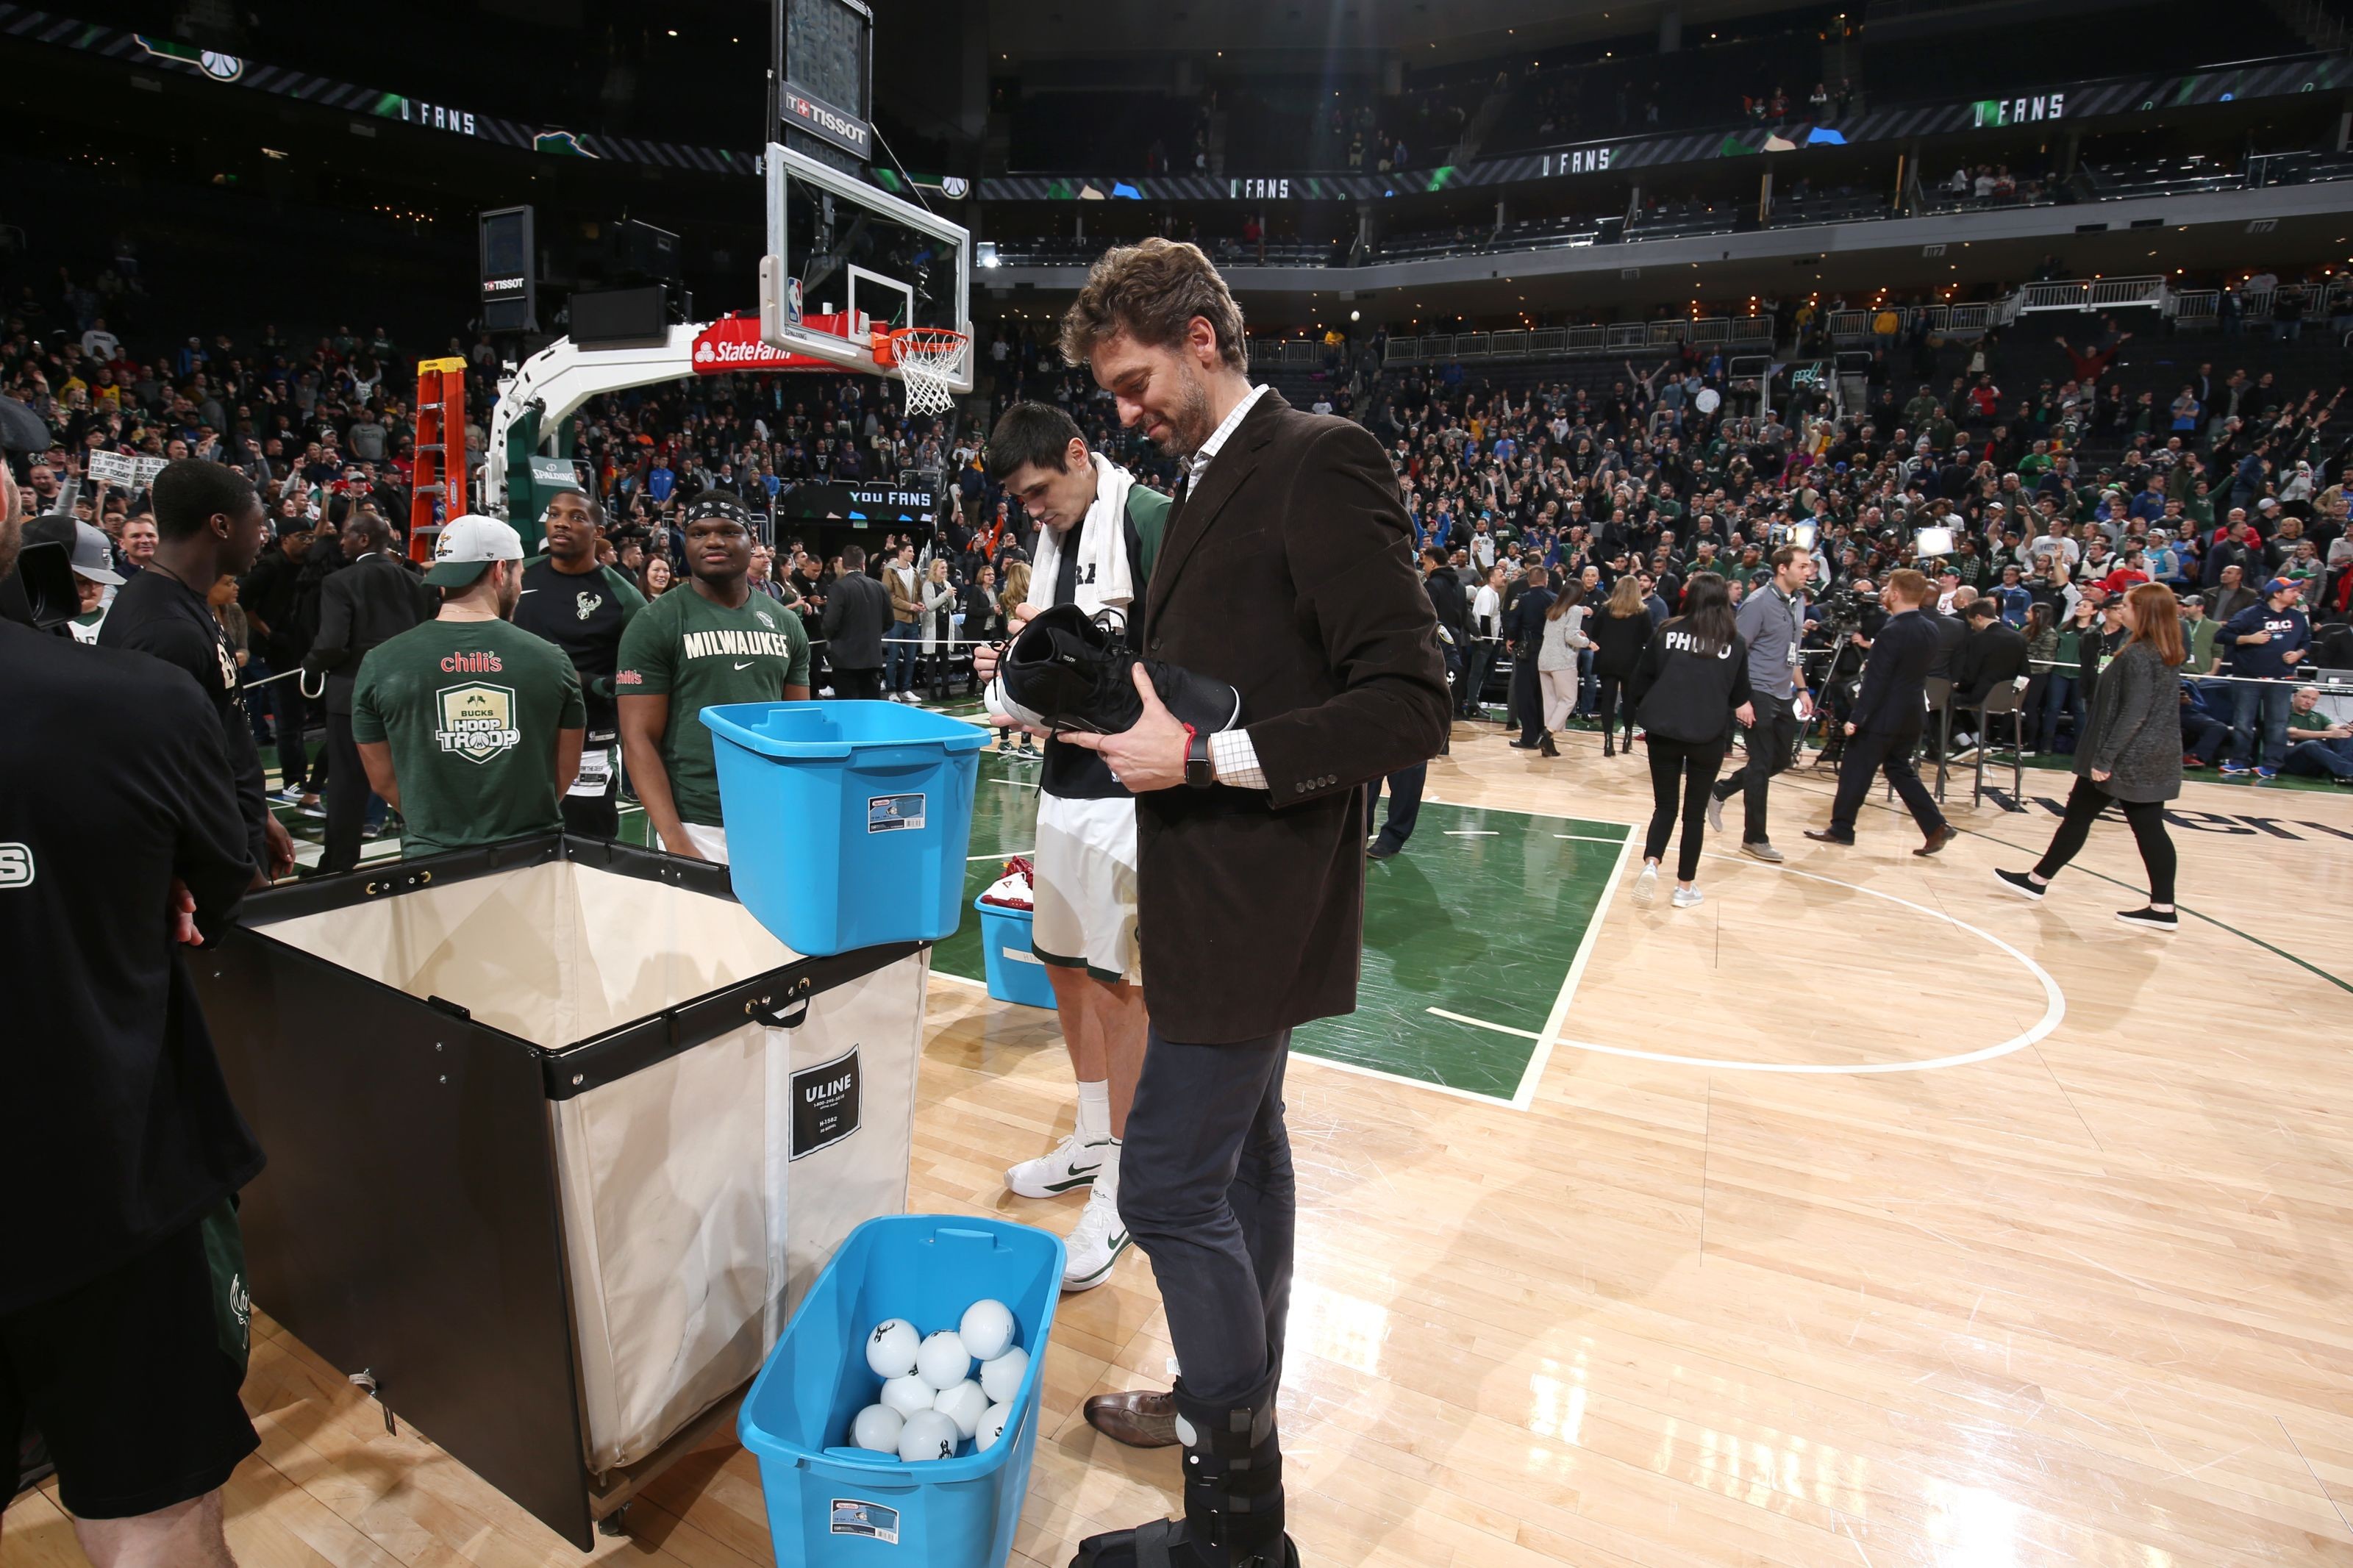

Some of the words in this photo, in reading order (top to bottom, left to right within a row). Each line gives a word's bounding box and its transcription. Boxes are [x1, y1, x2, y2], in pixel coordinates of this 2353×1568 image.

[421, 103, 474, 135] FANS
[1997, 93, 2064, 125] FANS
[810, 104, 866, 145] TISSOT
[1560, 148, 1610, 174] FANS
[1246, 179, 1288, 198] FANS
[494, 278, 524, 290] TISSOT
[785, 329, 807, 340] SPALDING
[532, 468, 575, 483] SPALDING
[849, 491, 882, 503] YOU
[888, 492, 931, 506] FANS
[683, 630, 788, 659] MILWAUKEE
[440, 651, 503, 673] chili's
[454, 719, 501, 732] HOOP
[806, 1073, 851, 1103] ULINE
[819, 1116, 838, 1127] H-1582
